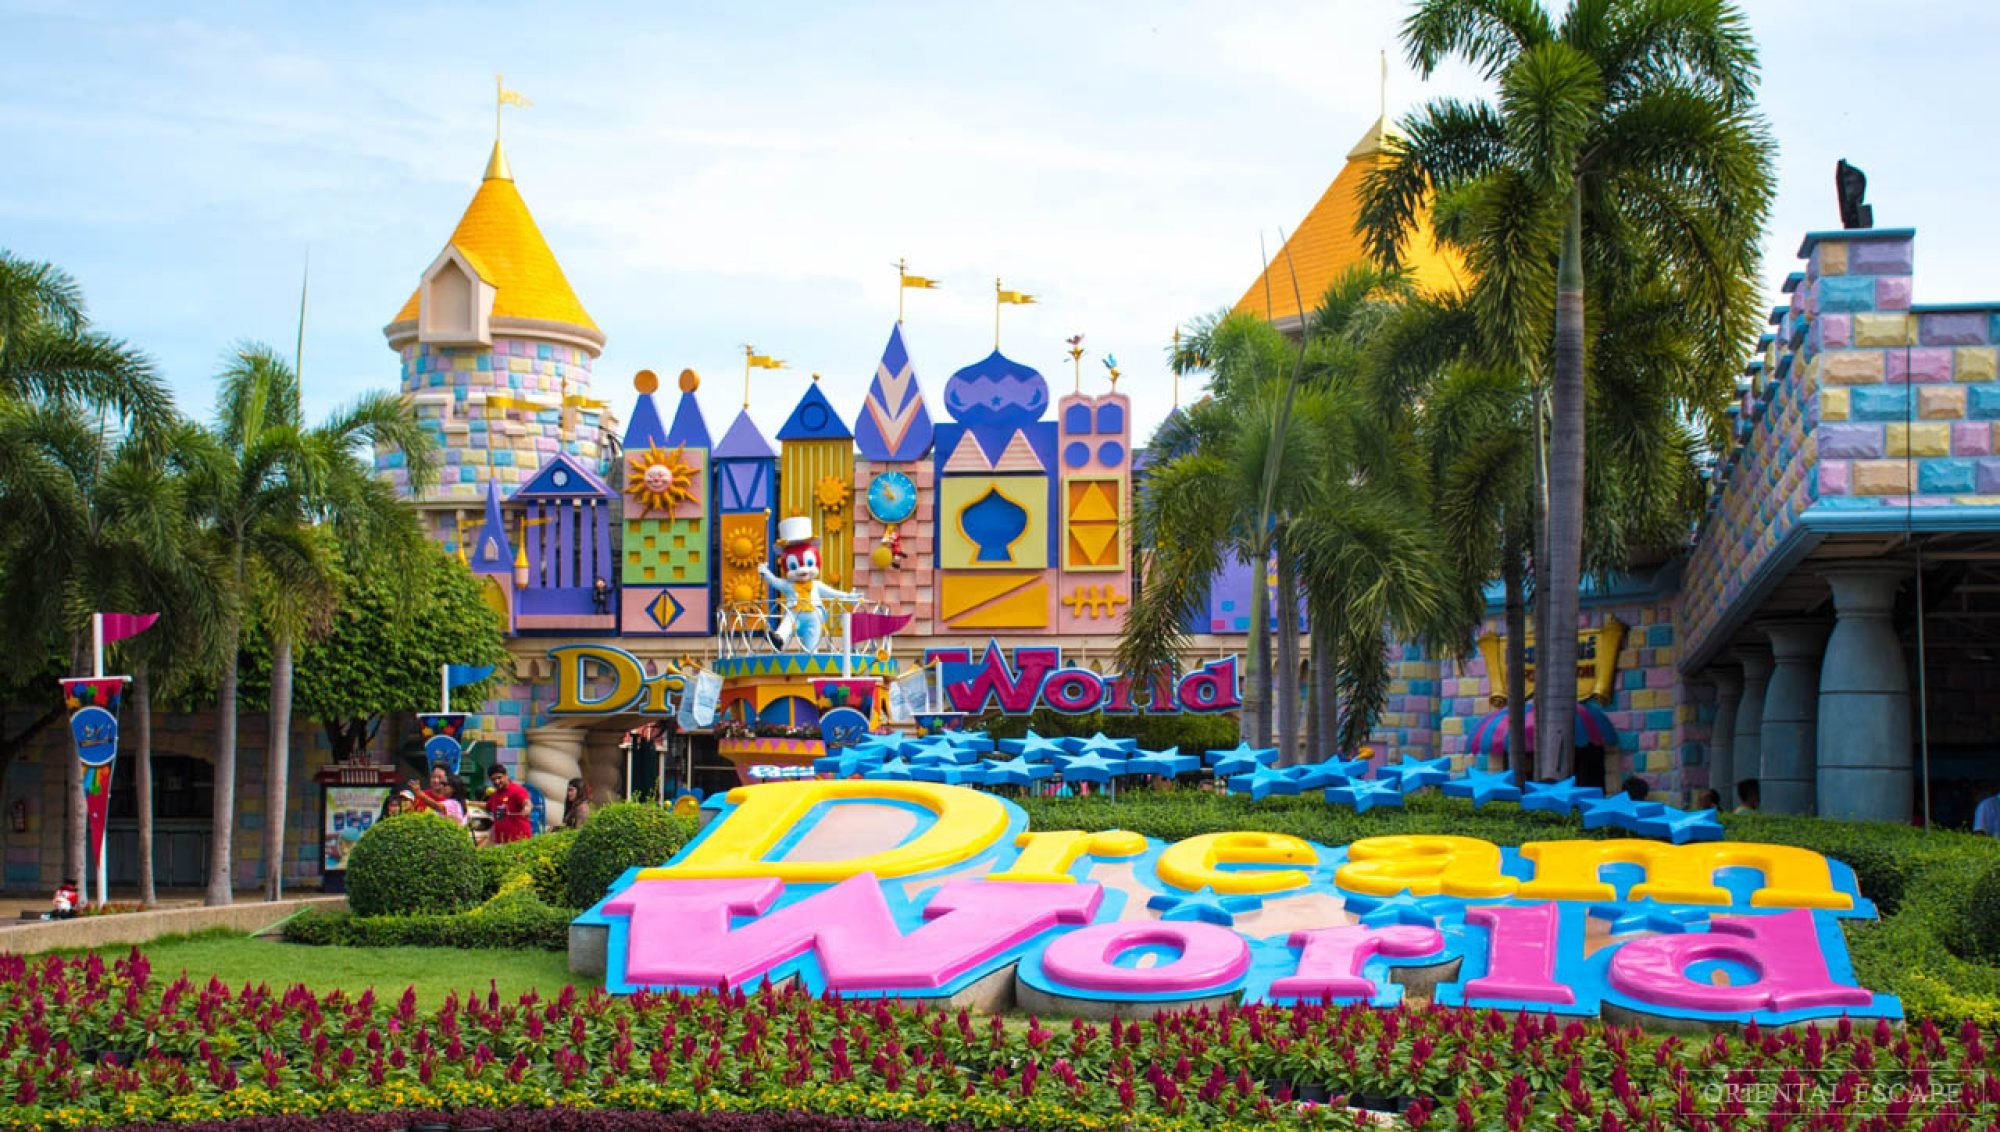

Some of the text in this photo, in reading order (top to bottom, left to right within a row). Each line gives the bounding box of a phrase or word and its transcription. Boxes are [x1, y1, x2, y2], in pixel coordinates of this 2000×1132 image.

[925, 638, 1242, 714] World
[636, 780, 1854, 909] Dream
[601, 871, 1874, 1011] World
